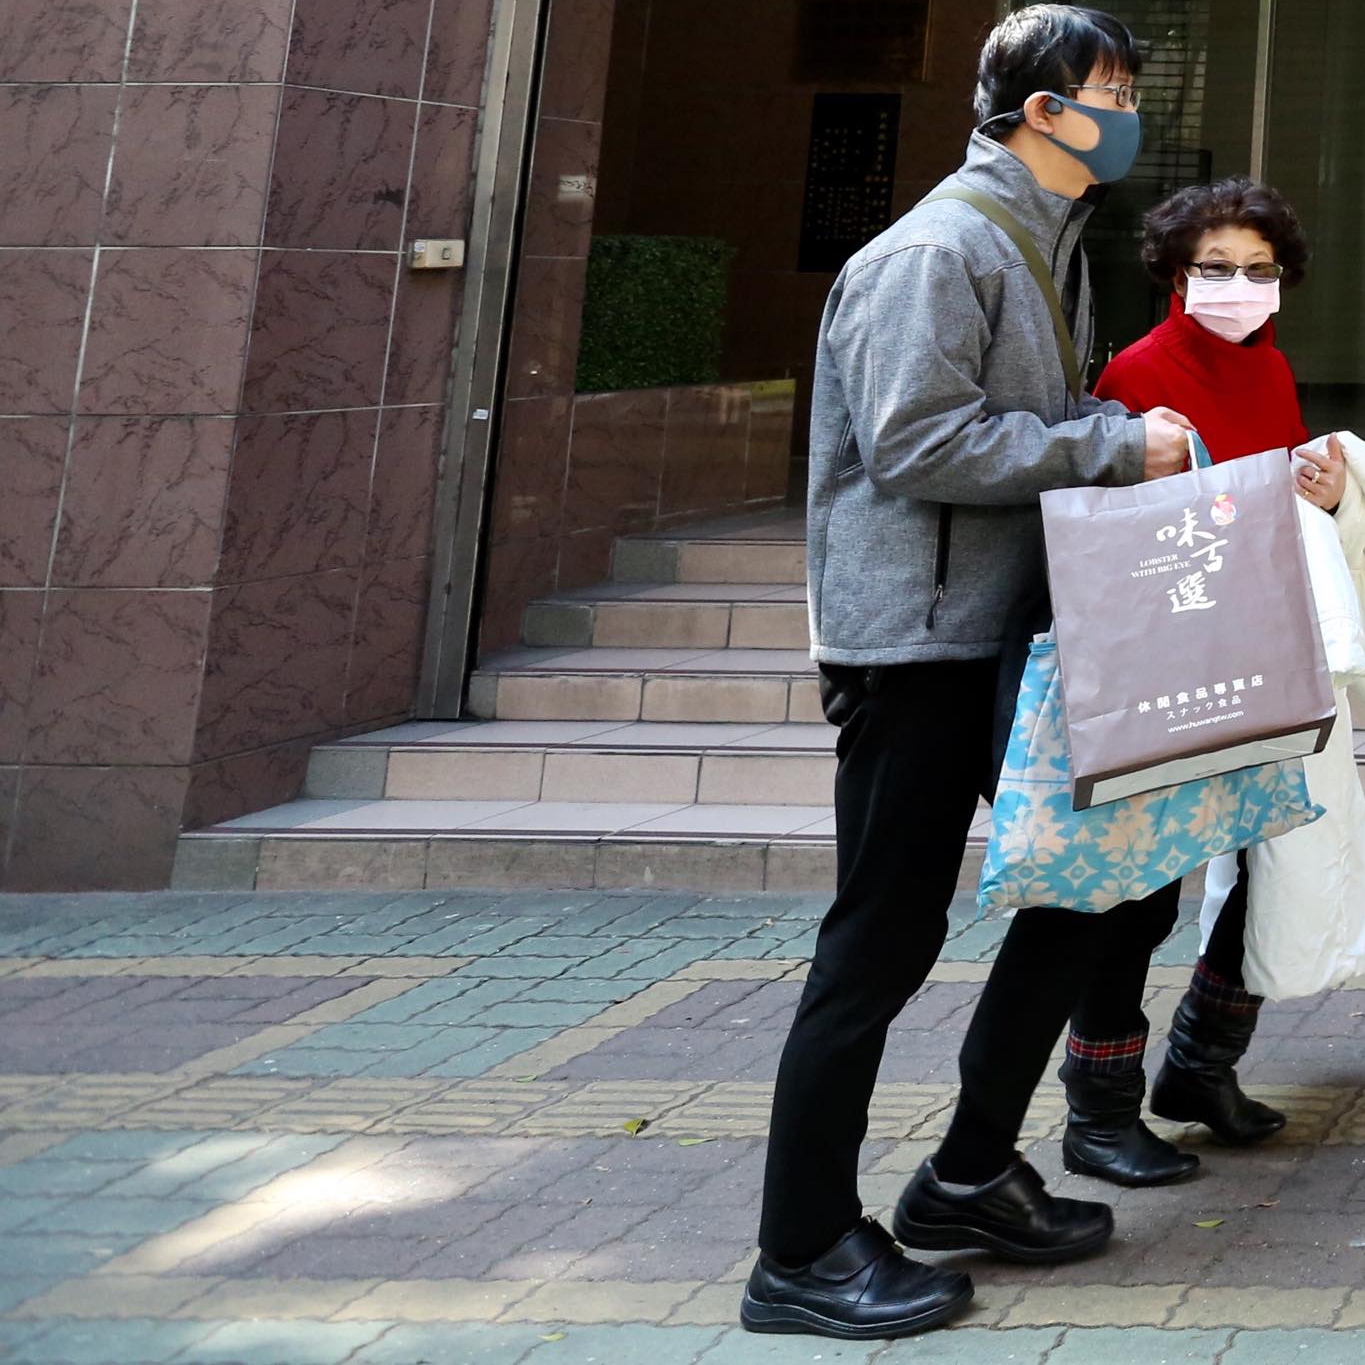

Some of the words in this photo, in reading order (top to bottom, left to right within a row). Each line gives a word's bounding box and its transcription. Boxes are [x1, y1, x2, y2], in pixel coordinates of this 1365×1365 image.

[1139, 553, 1179, 568] LOBSTER
[1131, 566, 1157, 579] WITH
[1157, 564, 1173, 575] BIG
[1174, 560, 1192, 572] EYE
